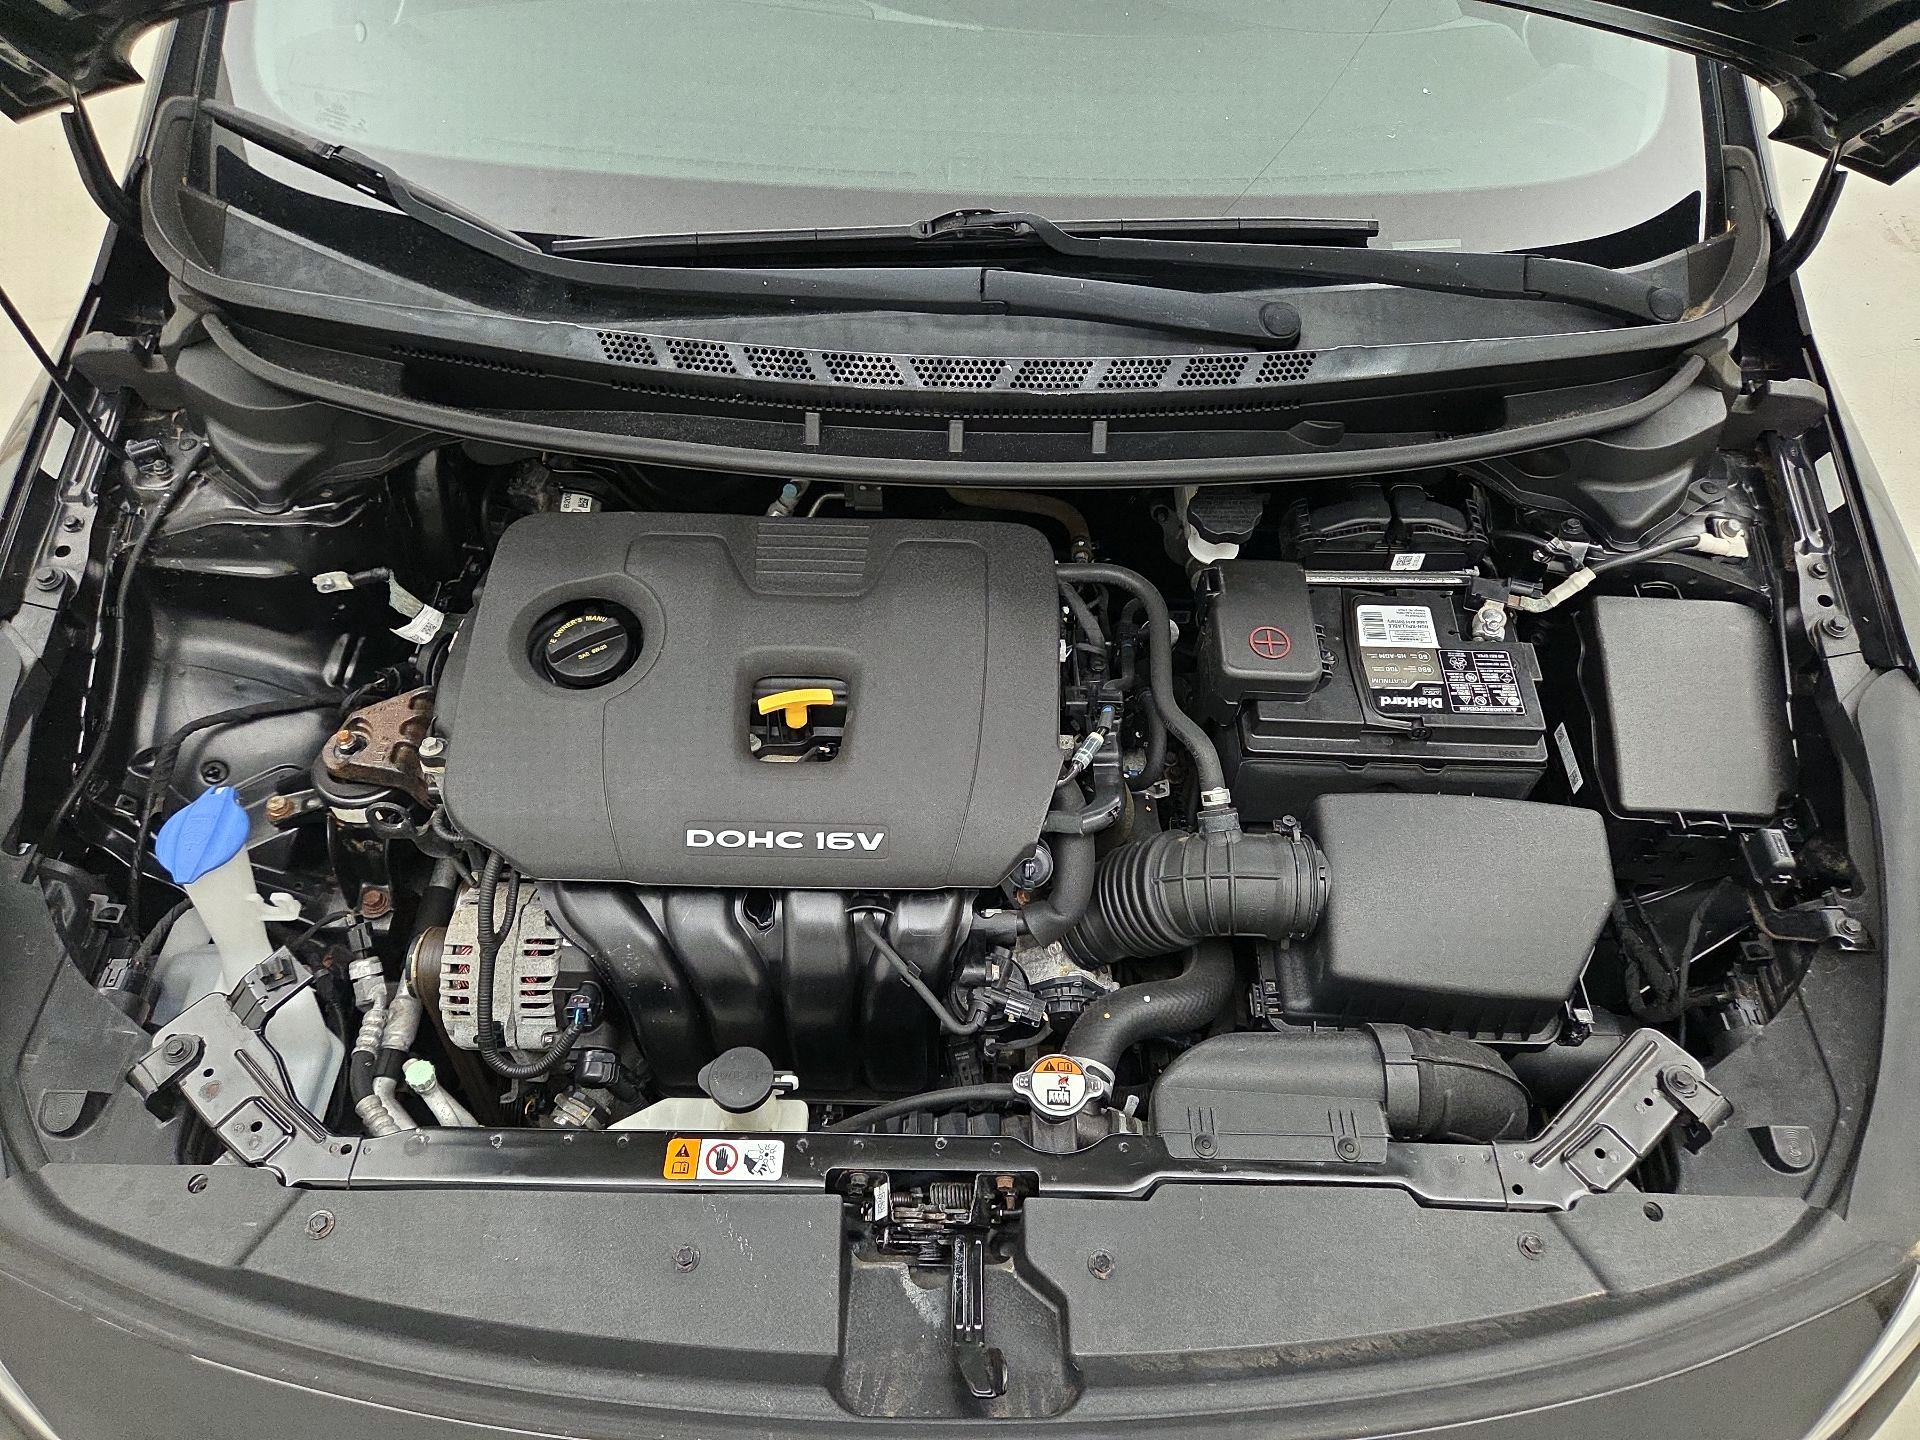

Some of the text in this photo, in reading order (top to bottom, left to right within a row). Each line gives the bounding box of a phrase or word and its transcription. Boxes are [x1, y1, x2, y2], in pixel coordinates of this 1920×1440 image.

[553, 617, 583, 638] OWNER'S
[1380, 697, 1443, 708] DieHard
[686, 829, 885, 851] DOHC 16V
